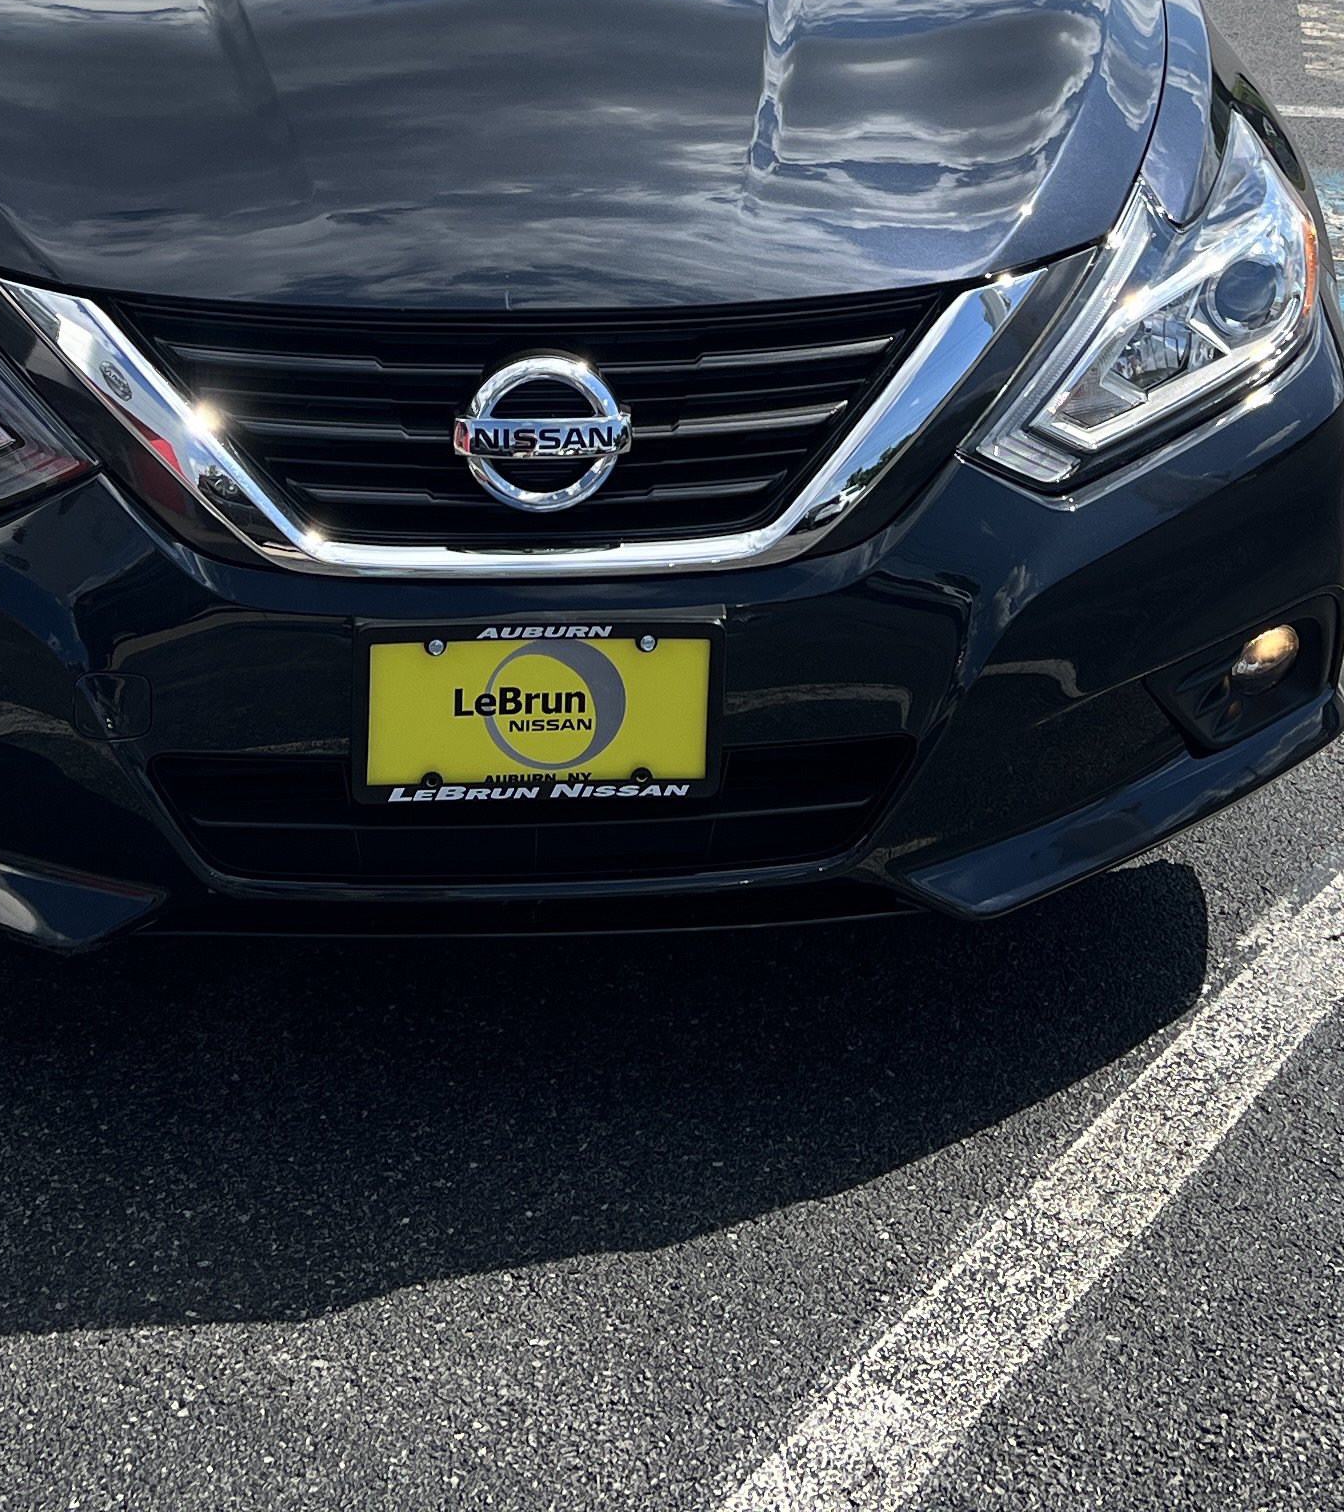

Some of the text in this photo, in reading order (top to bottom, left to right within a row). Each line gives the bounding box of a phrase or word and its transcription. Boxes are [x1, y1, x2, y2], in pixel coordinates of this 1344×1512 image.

[474, 426, 613, 449] NISSAN
[476, 625, 612, 639] AUBURN
[453, 686, 586, 717] LeBrun
[508, 718, 592, 732] NISSAN
[567, 772, 592, 782] NY
[550, 783, 690, 800] NISSAN
